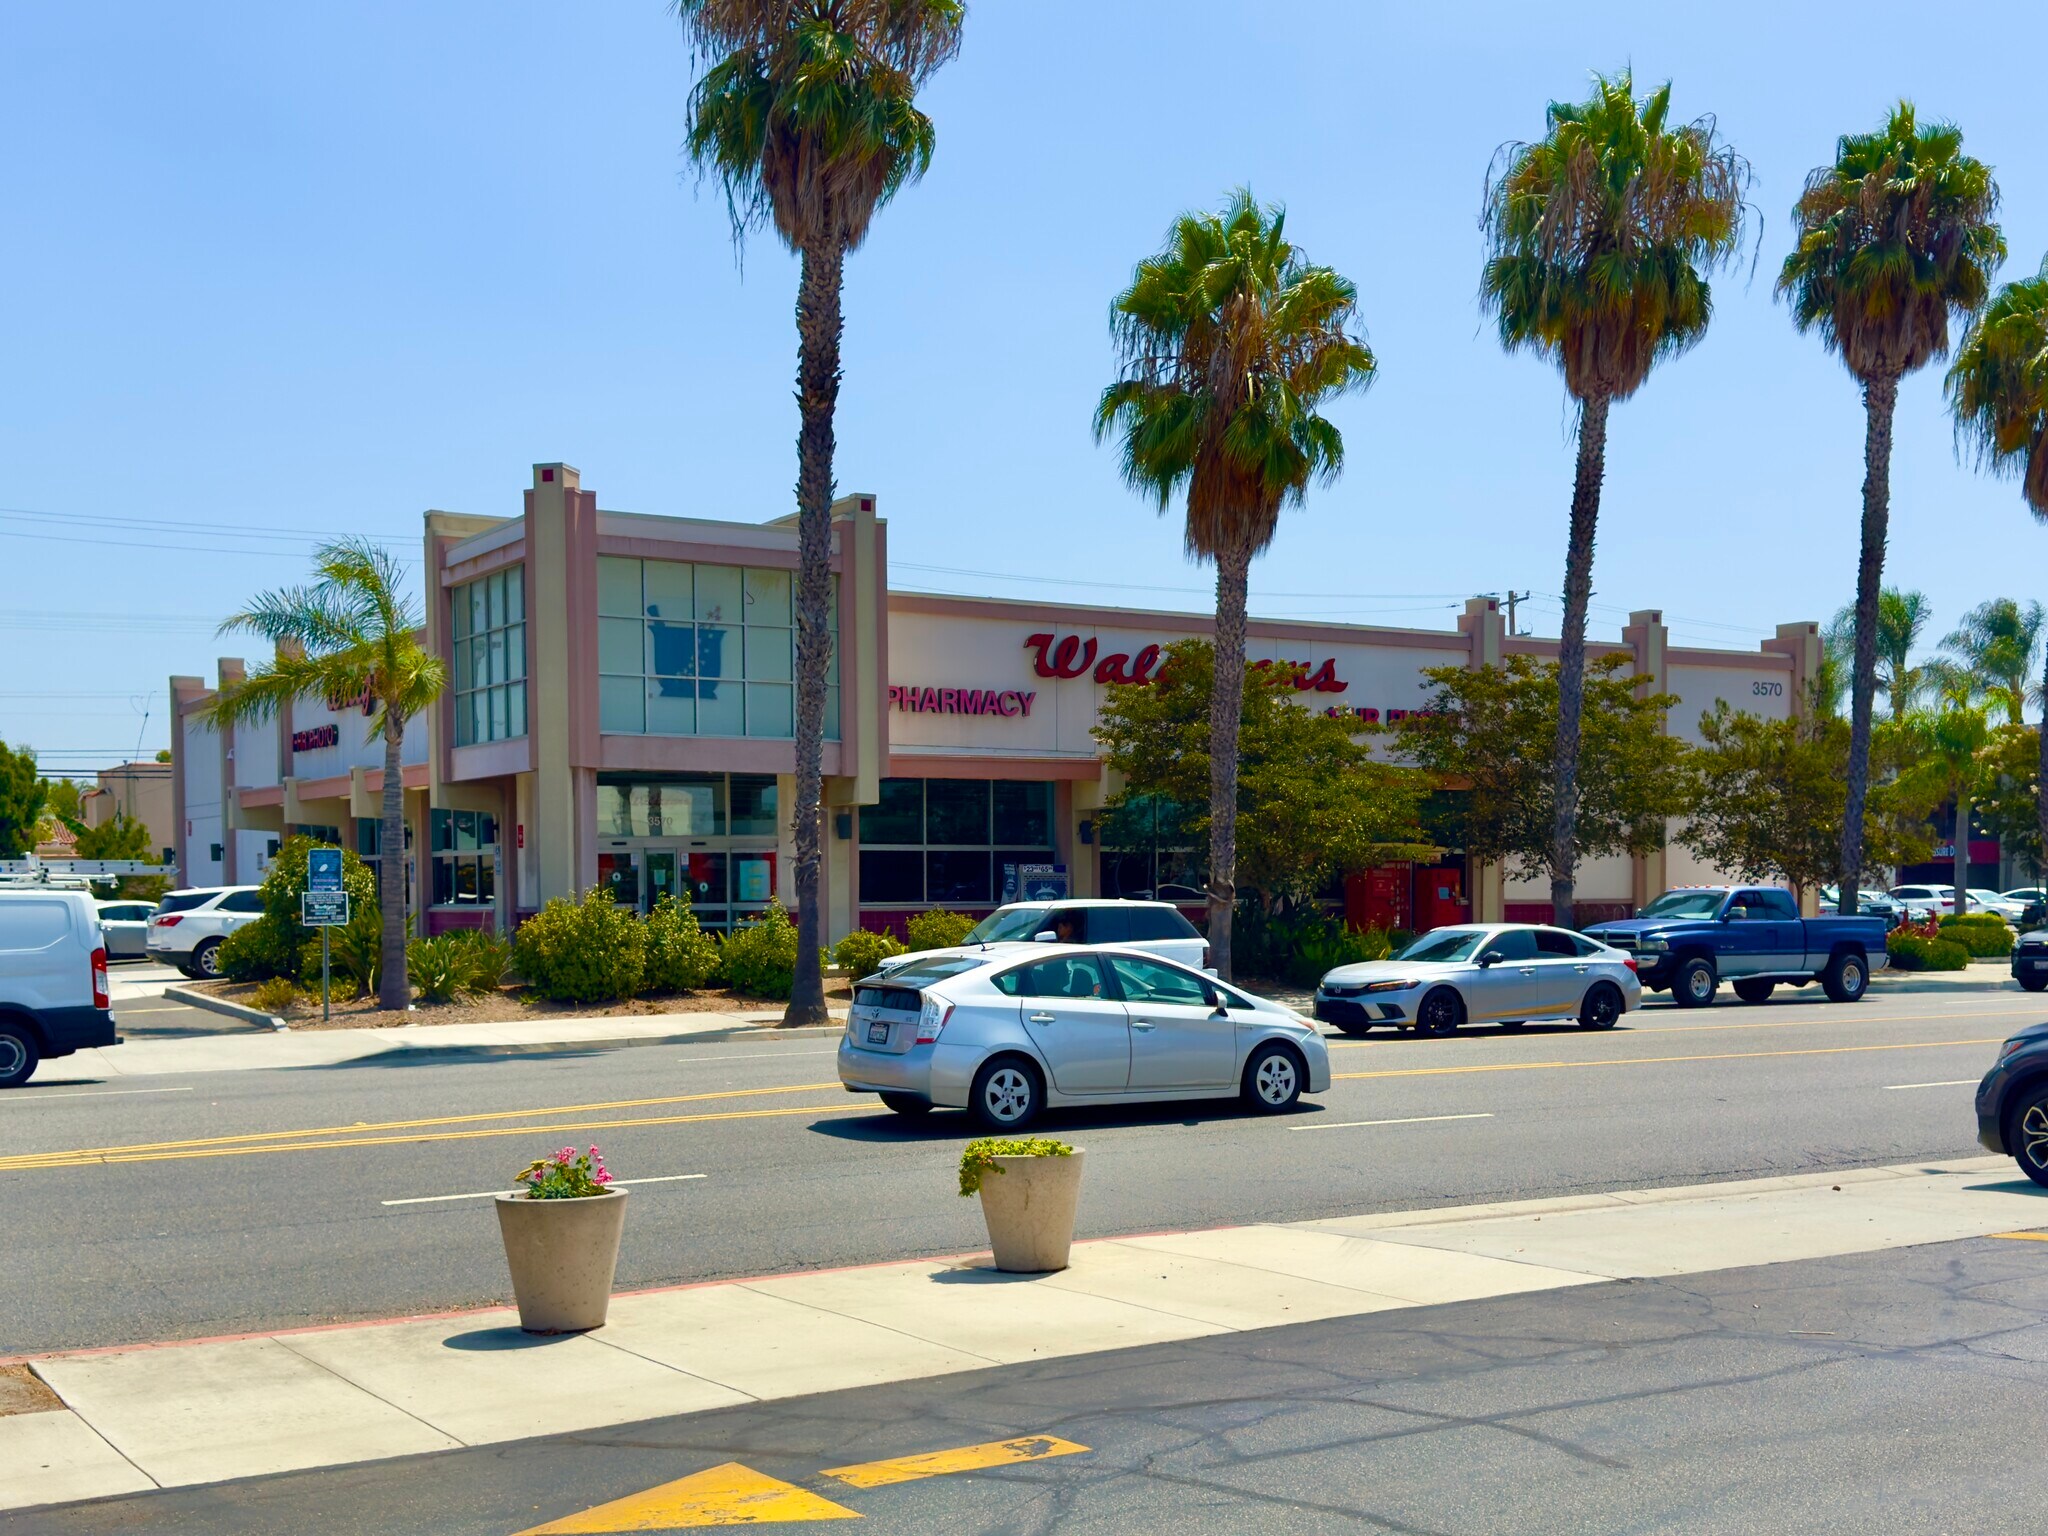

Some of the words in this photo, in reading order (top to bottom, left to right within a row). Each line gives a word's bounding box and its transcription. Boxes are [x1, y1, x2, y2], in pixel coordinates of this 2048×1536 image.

[1752, 681, 1783, 697] 3570
[888, 685, 1037, 717] PHARMACY
[649, 816, 673, 826] 3570
